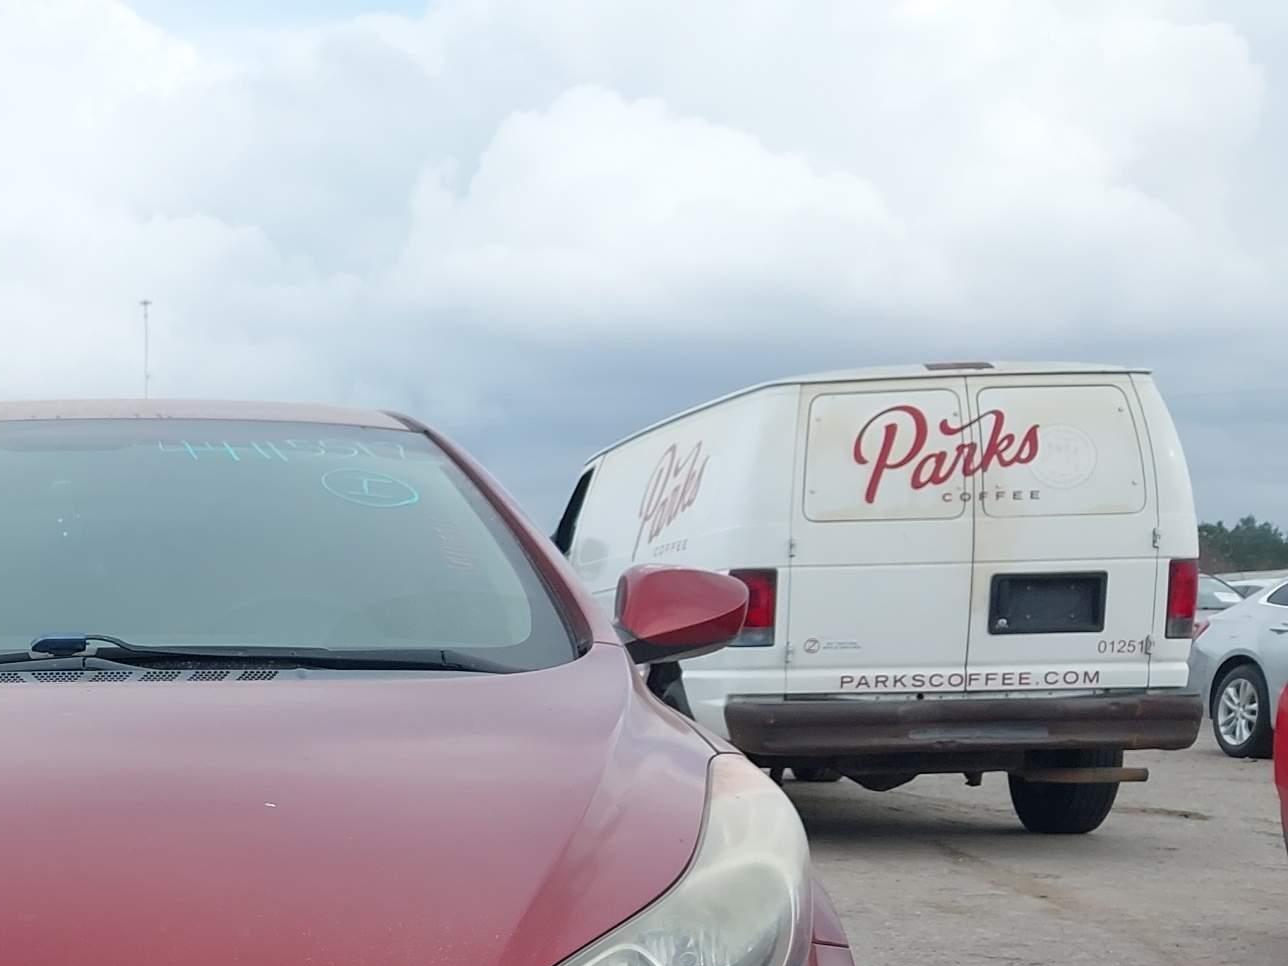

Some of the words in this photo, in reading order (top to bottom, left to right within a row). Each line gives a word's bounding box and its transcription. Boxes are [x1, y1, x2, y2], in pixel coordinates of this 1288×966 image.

[854, 405, 1040, 504] Parks
[631, 441, 710, 562] Parks
[941, 489, 1041, 503] COFFEE
[839, 670, 1101, 689] PARKSCOFFEE.COM
